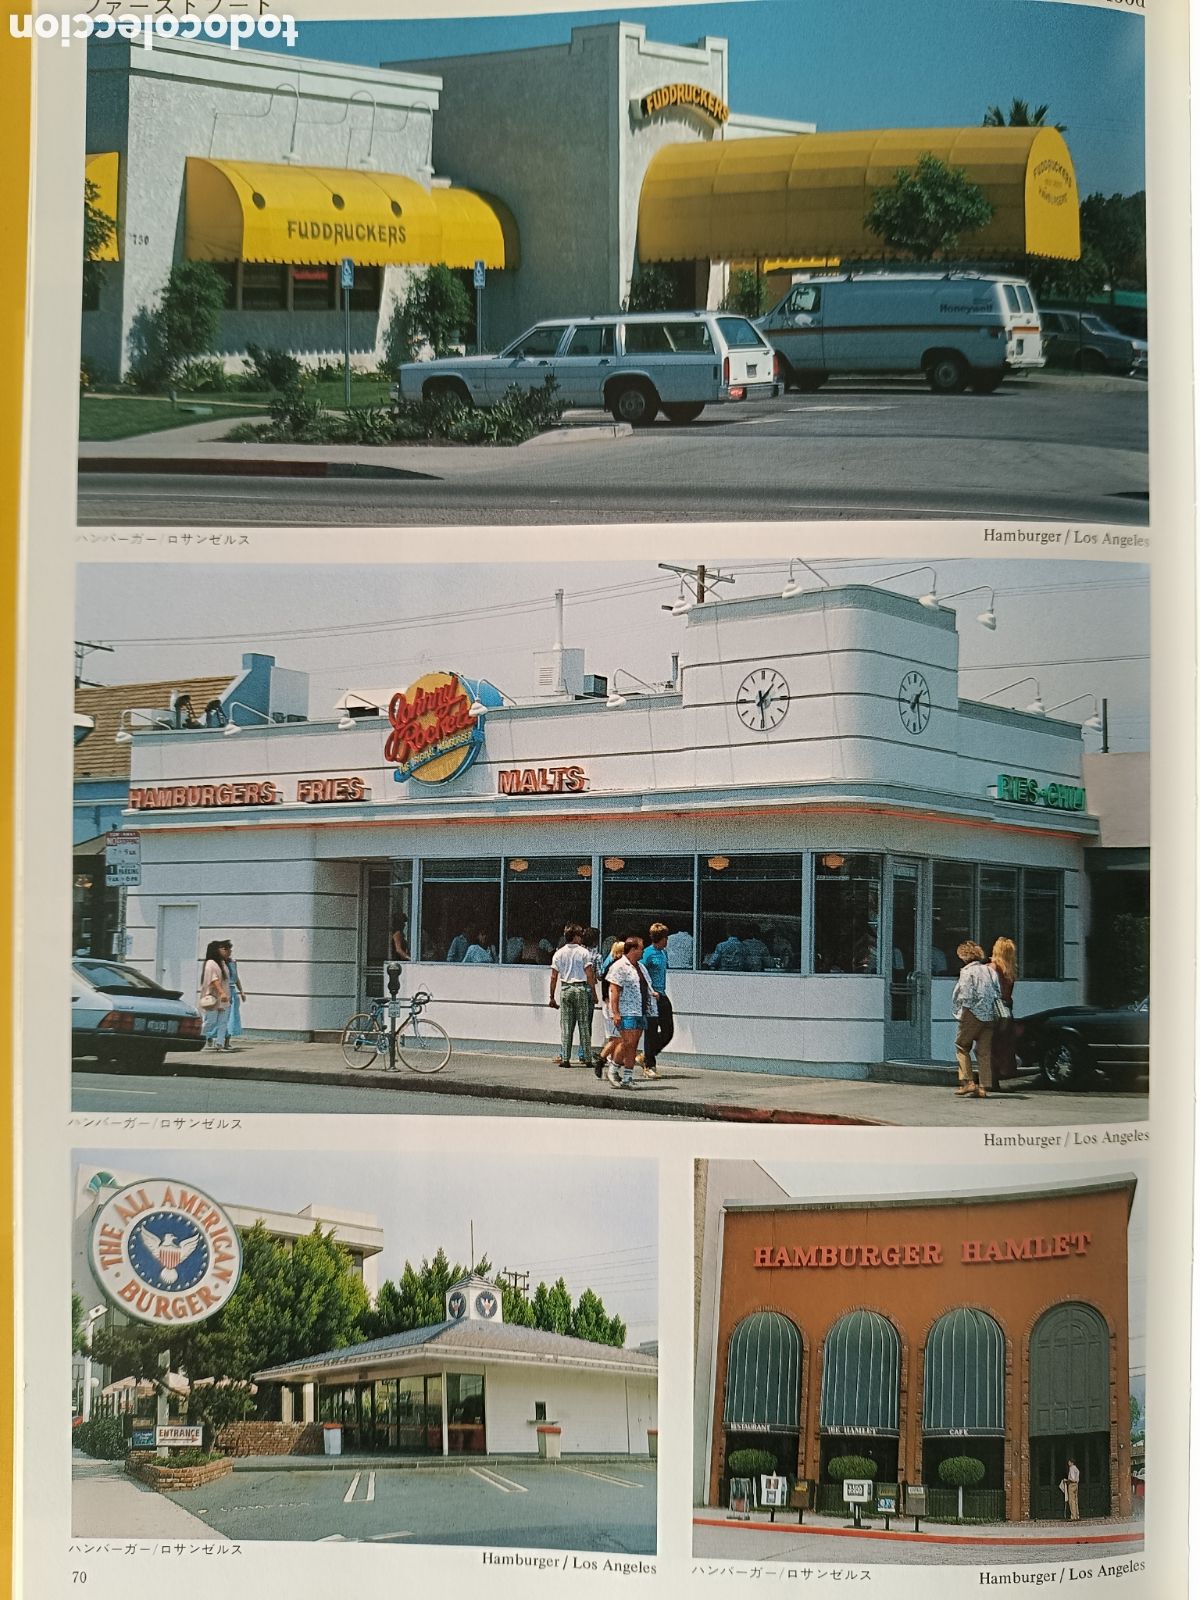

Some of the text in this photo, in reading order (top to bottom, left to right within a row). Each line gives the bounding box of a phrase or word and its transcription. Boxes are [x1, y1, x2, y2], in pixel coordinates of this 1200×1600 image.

[646, 83, 730, 122] FUDDRUCKERS
[287, 220, 407, 248] FUDDRUCKERS
[940, 303, 993, 314] Honeywell
[984, 528, 1061, 545] Hamburger
[1074, 530, 1098, 544] Los
[1101, 532, 1150, 548] Angeles
[389, 675, 467, 730] Johnny
[128, 765, 585, 809] HAMBURGERS FRIES MALTS
[984, 1133, 1061, 1149] Hamburger
[1074, 1132, 1098, 1145] Los
[1102, 1129, 1150, 1145] Angeles
[98, 1185, 236, 1285] THE ALL AMERICAN
[753, 1231, 1092, 1269] HAMBURGER HAMLET
[117, 1279, 222, 1321] BURGER
[159, 1428, 200, 1437] ENTRANCE
[730, 1422, 771, 1432] RESTAURANT
[482, 1552, 560, 1570] Hamburger
[573, 1556, 598, 1570] Los
[602, 1559, 657, 1575] Angeles
[979, 1571, 1057, 1586] Hamburger
[1069, 1567, 1093, 1580] Los
[1097, 1560, 1146, 1578] Angeles
[72, 1571, 87, 1584] 70
